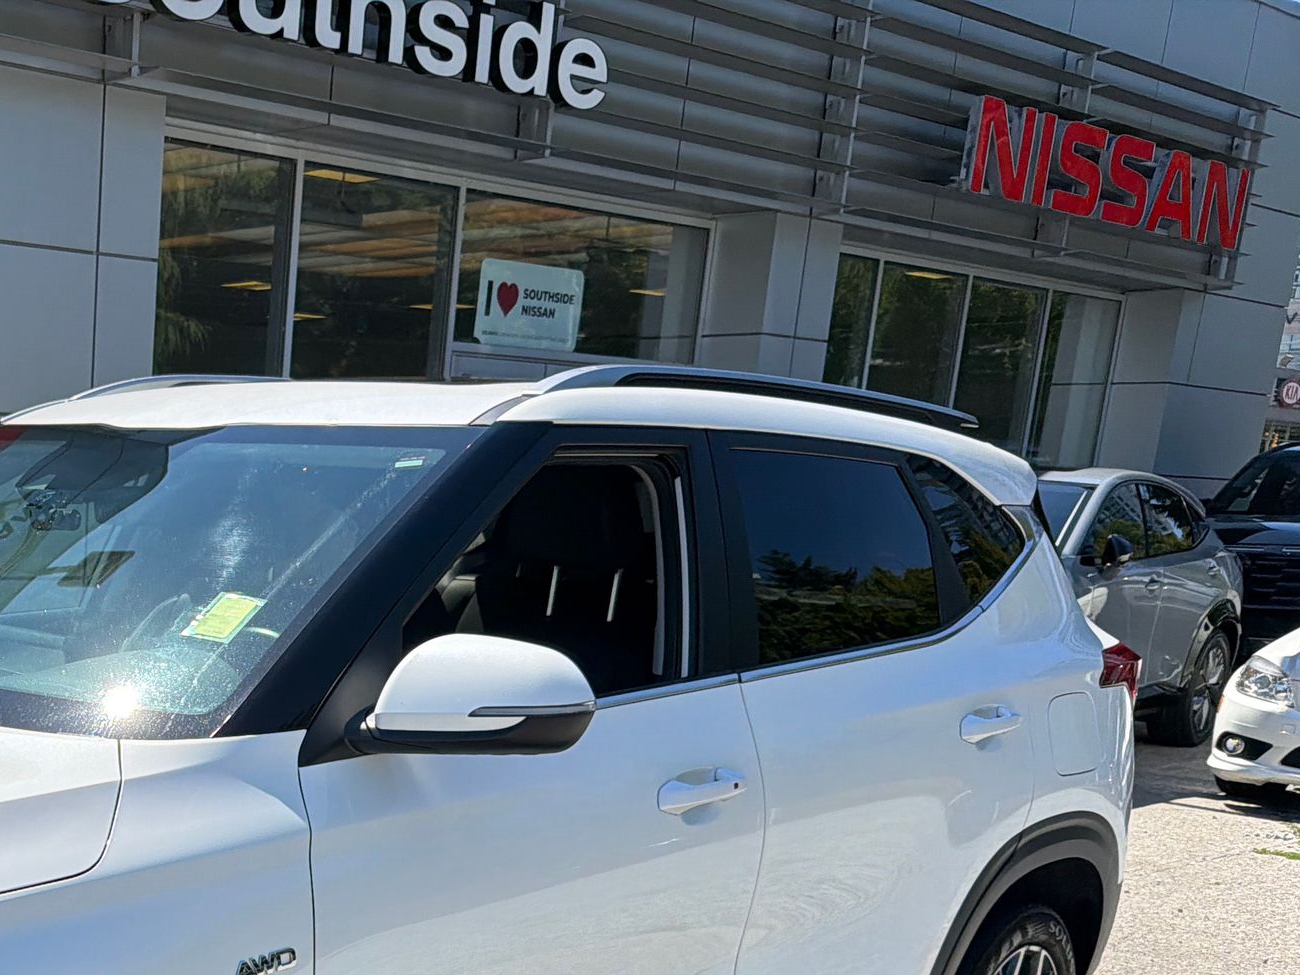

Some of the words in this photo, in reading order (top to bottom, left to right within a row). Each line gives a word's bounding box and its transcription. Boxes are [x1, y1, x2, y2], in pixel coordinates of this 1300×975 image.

[98, 0, 608, 110] uthside
[969, 94, 1251, 251] NISSAN
[522, 288, 575, 305] SOUTHSIDE
[521, 304, 556, 319] NISSAN
[1285, 383, 1300, 400] KIA
